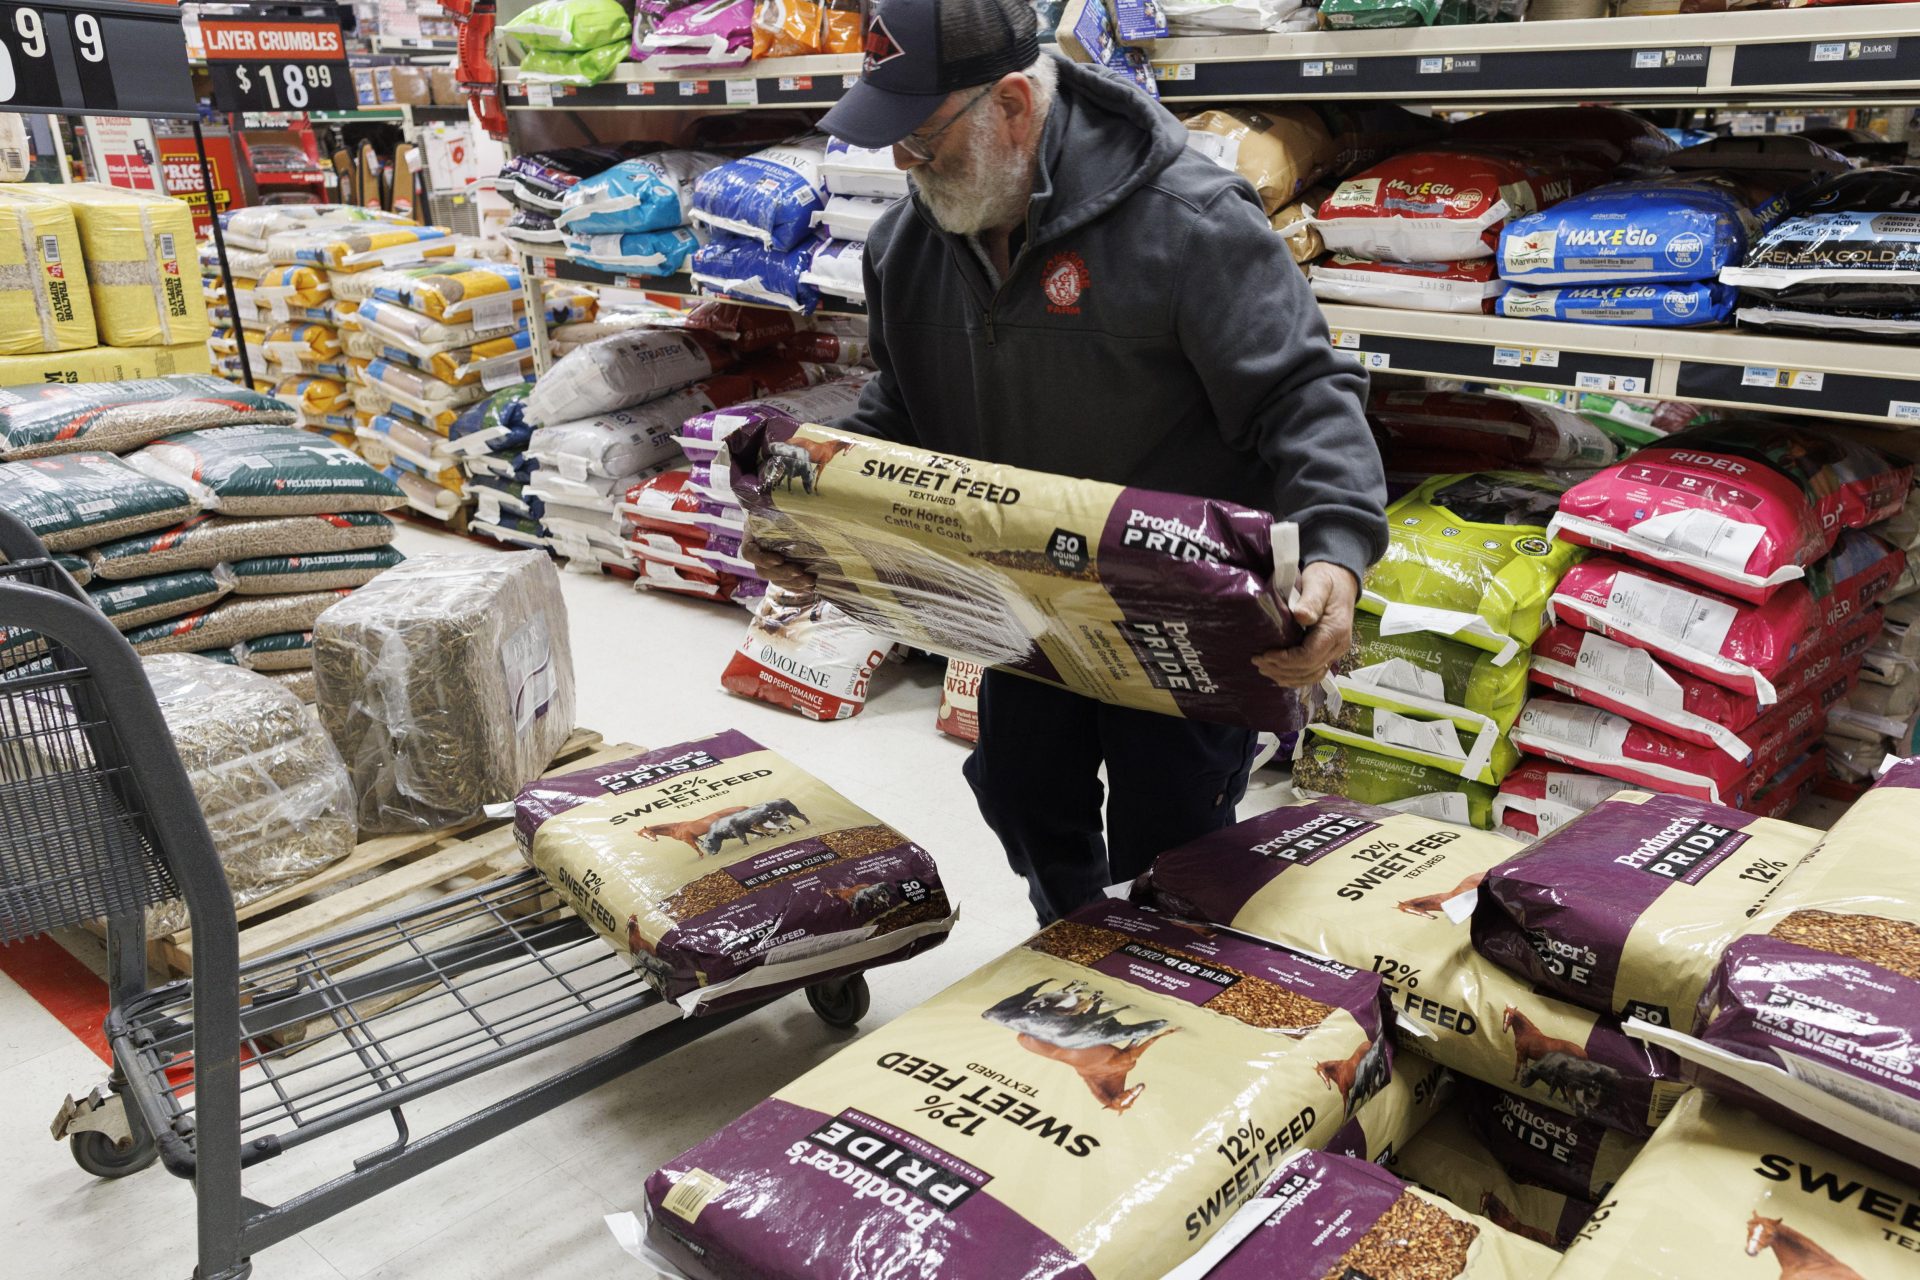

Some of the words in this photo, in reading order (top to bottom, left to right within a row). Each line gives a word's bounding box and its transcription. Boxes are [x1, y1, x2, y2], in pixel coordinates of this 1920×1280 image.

[205, 30, 256, 50] LAYER
[259, 30, 338, 51] CRUMBLES
[1862, 44, 1892, 53] DuMOR
[1668, 243, 1700, 252] FRESH
[1759, 251, 1833, 264] RENEW
[1836, 251, 1896, 262] GOLD
[49, 282, 62, 314] SUPPLY
[58, 281, 73, 321] TRACTOR
[165, 278, 177, 309] SUPPLY
[173, 278, 187, 316] TRACTOR
[1666, 293, 1697, 304] FRESH
[636, 345, 682, 362] STRATEGY
[1670, 452, 1747, 476] RIDER
[286, 479, 332, 488] PELLETIZED
[333, 479, 365, 488] BEDDING
[860, 459, 950, 492] SWEET
[952, 478, 1021, 506] FEED
[908, 490, 956, 506] TEXTURED
[30, 513, 68, 528] BEDDING
[893, 504, 913, 517] For
[916, 509, 963, 529] Horses,
[884, 515, 921, 531] Cattle
[924, 524, 932, 533] &
[936, 526, 973, 544] Goats
[1055, 535, 1079, 553] 50
[1053, 551, 1080, 562] POUND
[1059, 559, 1075, 568] BAG
[1133, 624, 1191, 690] PRIDE
[1369, 641, 1426, 659] PERFORMANCE
[1426, 651, 1442, 664] LS
[759, 670, 773, 684] 200
[772, 674, 824, 705] PERFORMANCE
[595, 750, 708, 786] Producer's
[608, 756, 714, 791] PRIDE
[1356, 756, 1411, 774] PERFORMANCE
[1410, 766, 1426, 778] LS
[657, 775, 708, 795] 12%
[609, 788, 701, 826] SWEET
[707, 769, 773, 792] FEED
[674, 790, 731, 809] TEXTURED
[1249, 812, 1344, 857] Producer's
[1277, 818, 1370, 862] PRIDE
[1614, 816, 1701, 870] Producer's
[754, 857, 766, 865] For
[859, 855, 886, 866] Fiber-rich
[1351, 840, 1400, 864] 12%
[1650, 824, 1730, 878] PRIDE
[744, 878, 759, 887] NET
[759, 873, 772, 884] WT.
[772, 866, 789, 877] 50
[790, 862, 802, 872] lb
[753, 860, 775, 870] Cattle
[867, 862, 878, 870] with
[1336, 852, 1412, 901] SWEET
[1403, 831, 1462, 864] FEED
[1403, 855, 1446, 880] TEXTURED
[1686, 866, 1703, 883] QUALITY
[1739, 858, 1788, 884] 12%
[582, 869, 605, 896] 12%
[796, 879, 822, 891] nutrition
[902, 880, 921, 893] 50
[906, 889, 926, 899] POUND
[559, 867, 590, 905] SWEET
[591, 898, 616, 932] FEED
[913, 893, 925, 902] BAG
[717, 910, 735, 920] crude
[736, 903, 757, 914] protein
[730, 948, 749, 961] 12%
[750, 938, 782, 955] SWEET
[782, 928, 806, 942] FEED
[1128, 963, 1154, 975] Goats
[1164, 957, 1180, 966] lb
[1178, 962, 1201, 974] 50
[1199, 968, 1215, 978] WT.
[1290, 953, 1352, 980] Producer's
[1372, 954, 1422, 989] 12%
[1129, 969, 1161, 985] Horses,
[1161, 980, 1178, 990] For
[1163, 975, 1191, 988] Cattle
[1214, 971, 1233, 985] NET
[1852, 977, 1897, 993] protein
[1403, 993, 1477, 1036] FEED
[1635, 1006, 1662, 1025] 50
[1770, 983, 1879, 1025] Producer's
[1751, 1021, 1795, 1042] TEXTURED
[1794, 1038, 1812, 1049] FOR
[1813, 1045, 1849, 1063] HORSES,
[1850, 1057, 1884, 1076] CATTLE
[1885, 1070, 1891, 1078] &
[1755, 1008, 1788, 1030] 12%
[1792, 1021, 1859, 1052] SWEET
[1861, 1050, 1913, 1075] FEED
[876, 1052, 968, 1092] FEED
[966, 1062, 1039, 1098] TEXTURED
[846, 1111, 894, 1135] NUTRITION
[913, 1095, 988, 1137] 12%
[959, 1085, 1101, 1158] SWEET
[904, 1136, 933, 1154] VALUE
[1217, 1119, 1265, 1167] 12%
[814, 1121, 970, 1206] PRIDE
[942, 1157, 985, 1182] QUALITY
[1185, 1156, 1260, 1242] SWEET
[1264, 1106, 1316, 1166] FEED
[785, 1140, 947, 1234] Producer's
[1264, 1178, 1322, 1228] Producer's
[1334, 1209, 1352, 1227] crude
[1311, 1225, 1336, 1247] protein
[1335, 1226, 1352, 1239] 12%
